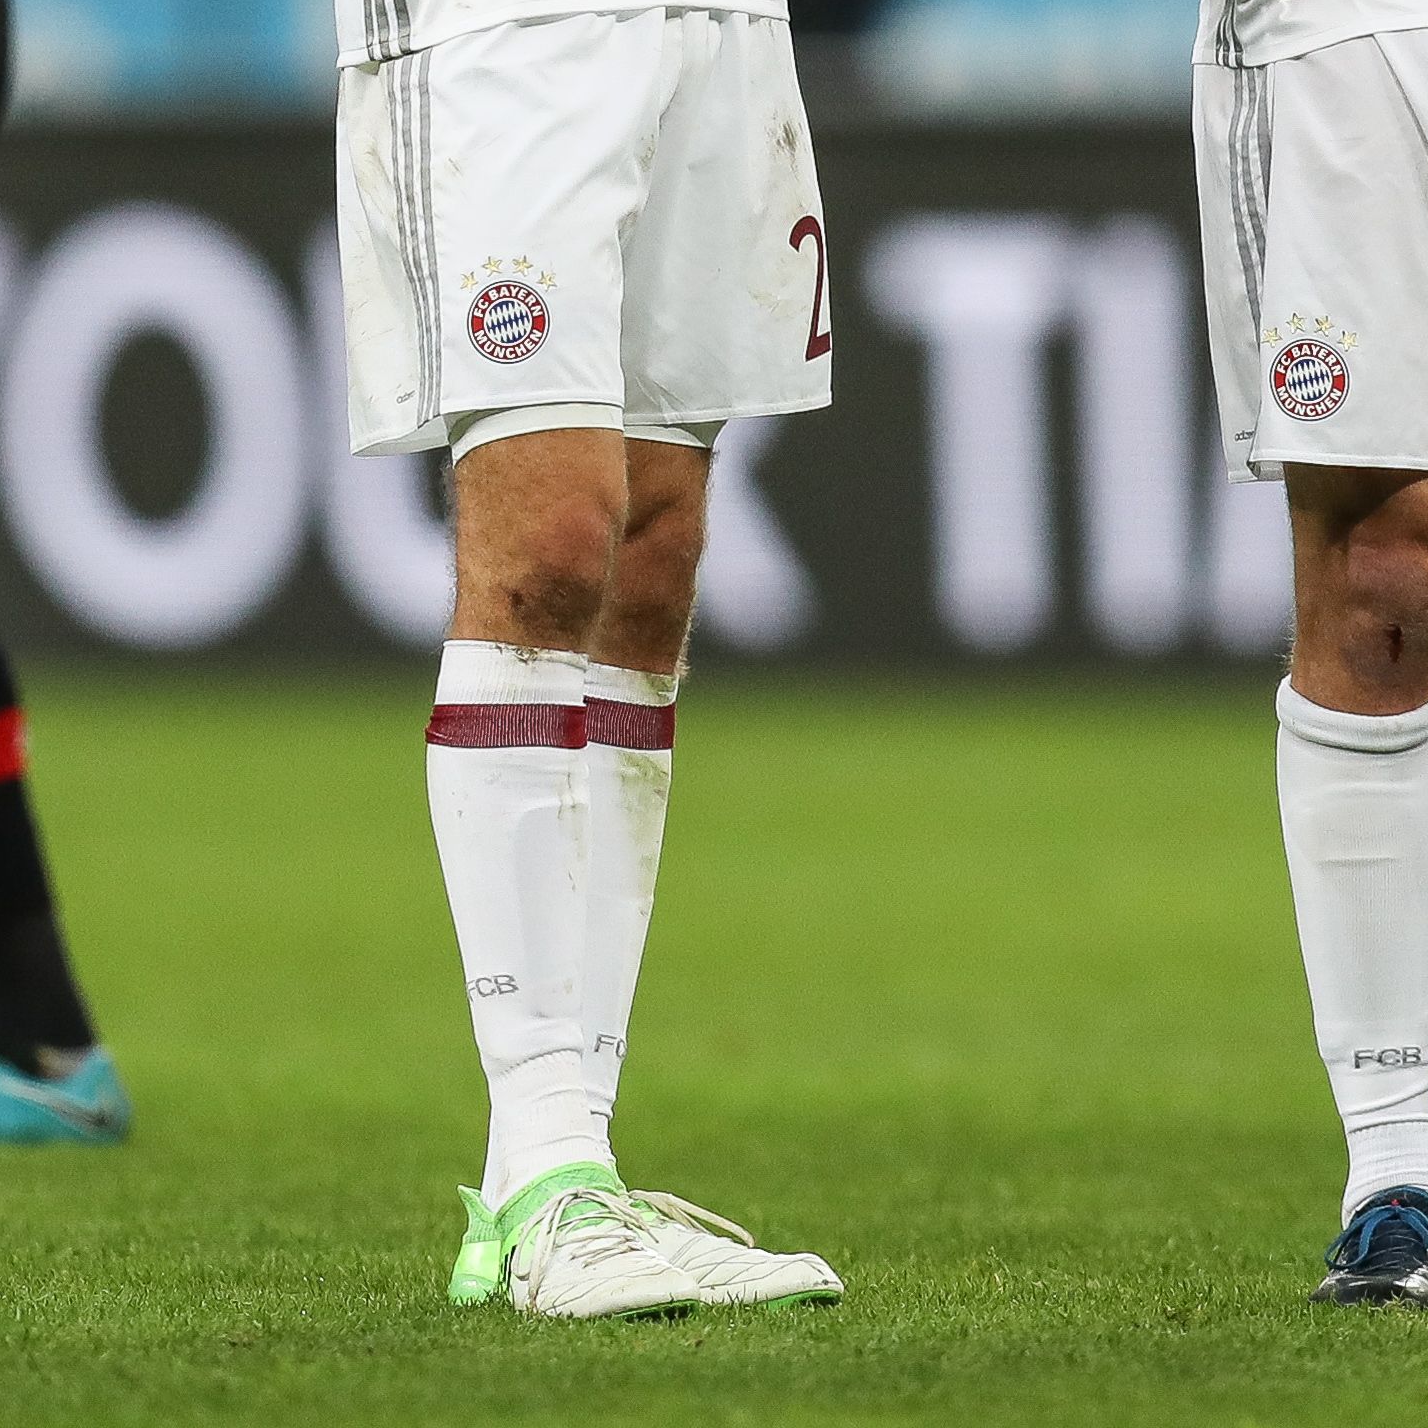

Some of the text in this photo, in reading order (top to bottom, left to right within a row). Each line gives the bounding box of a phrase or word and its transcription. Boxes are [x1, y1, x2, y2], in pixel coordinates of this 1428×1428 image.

[473, 286, 543, 318] FC BAYERN
[1276, 344, 1343, 376] FC BAYERN
[1354, 1046, 1421, 1069] FCB
